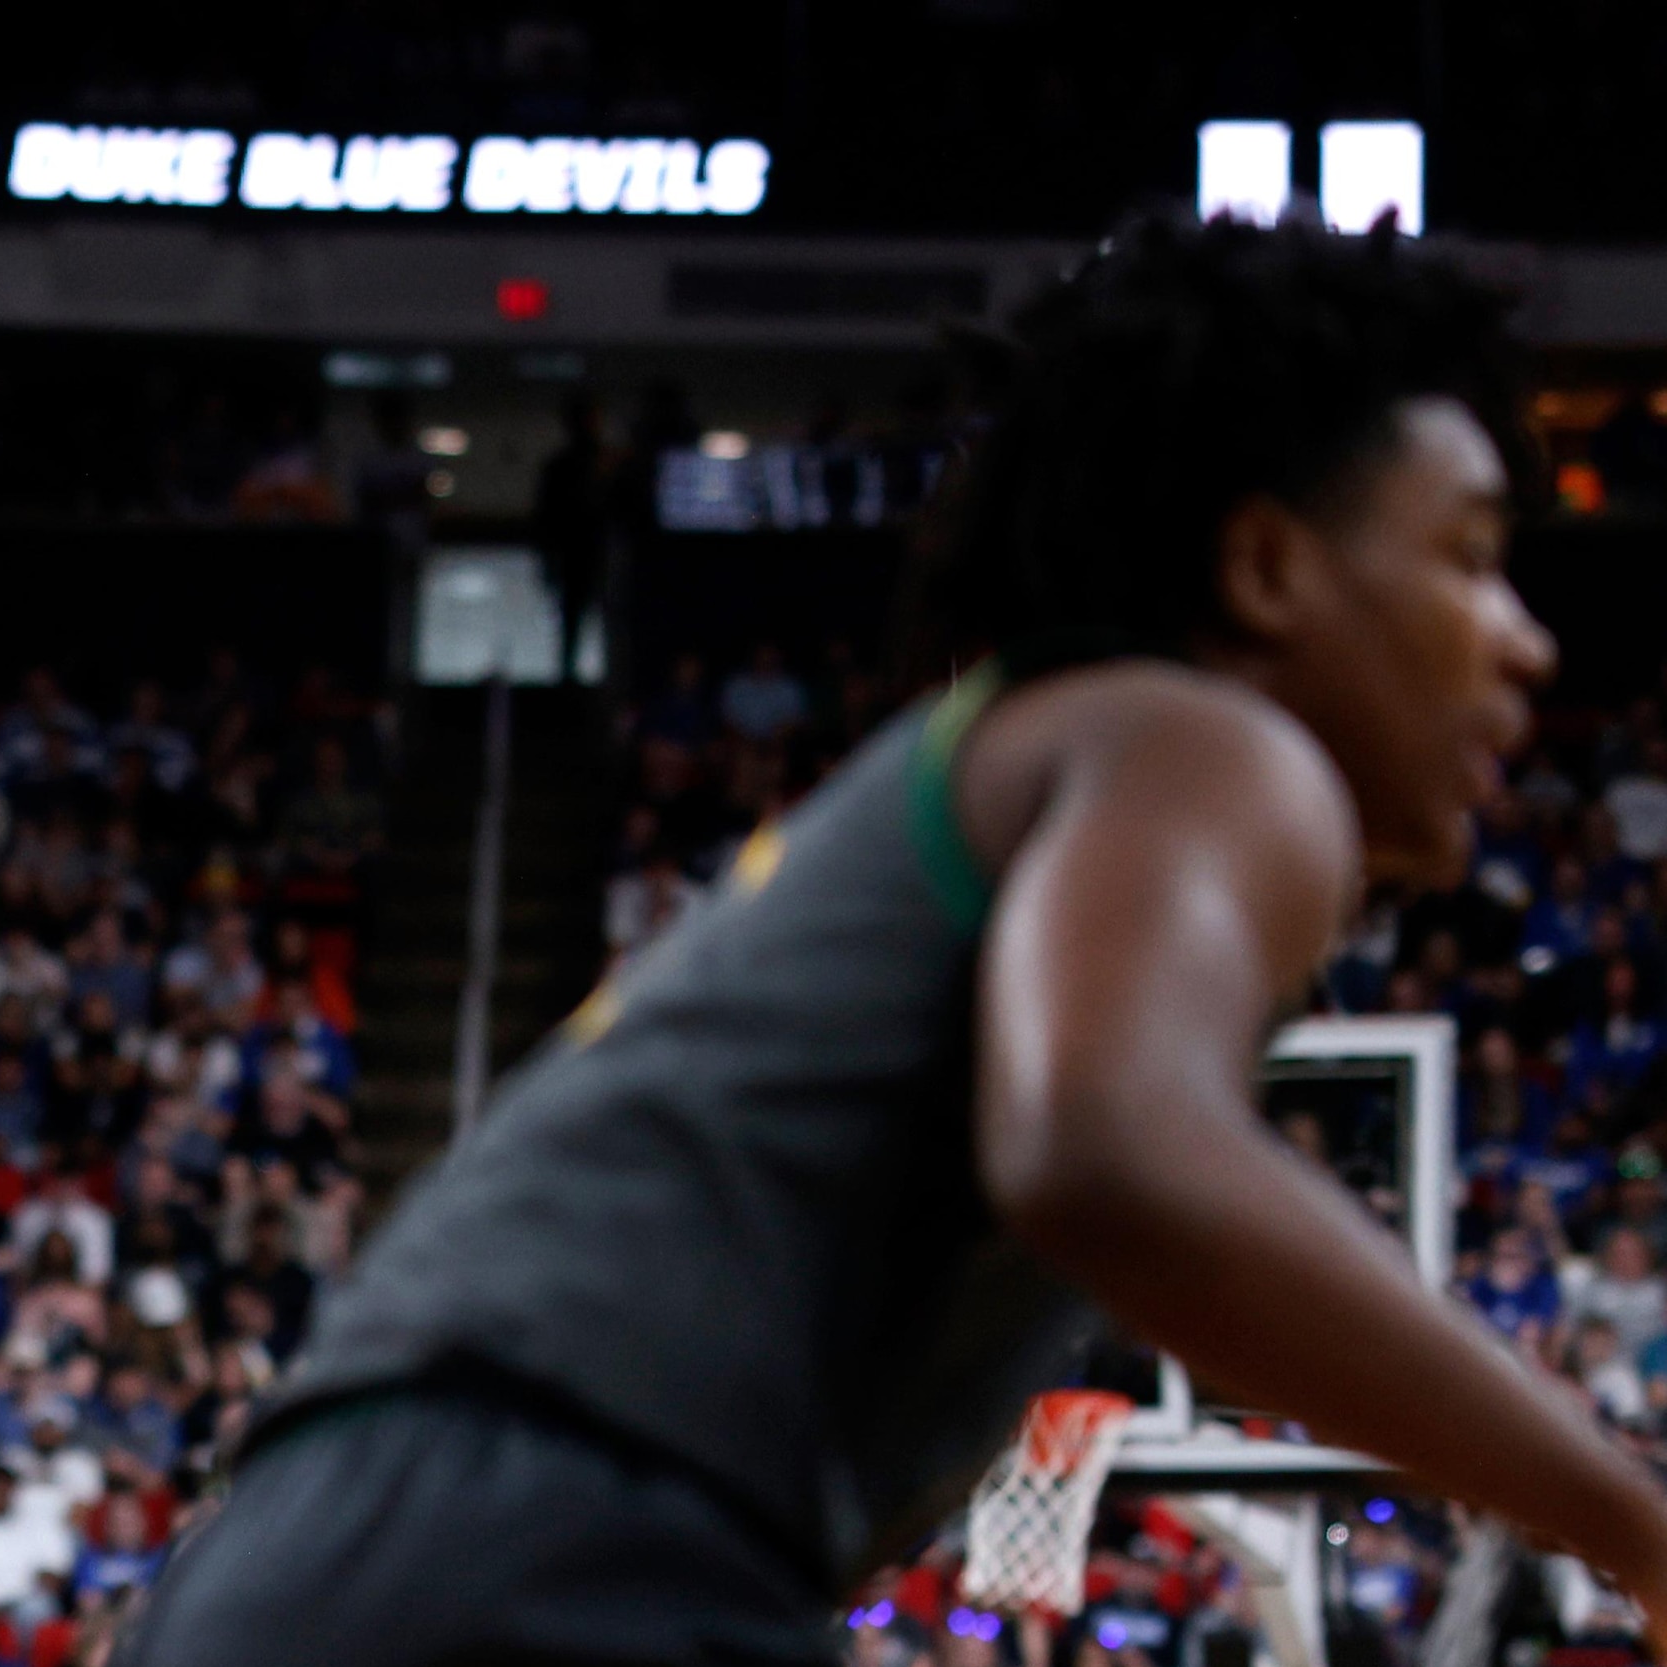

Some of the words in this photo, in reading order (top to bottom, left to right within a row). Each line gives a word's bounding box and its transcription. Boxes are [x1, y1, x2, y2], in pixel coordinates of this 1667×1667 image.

[9, 123, 236, 206] DUKE
[240, 132, 458, 212] BLUE
[464, 135, 770, 215] DEVILS
